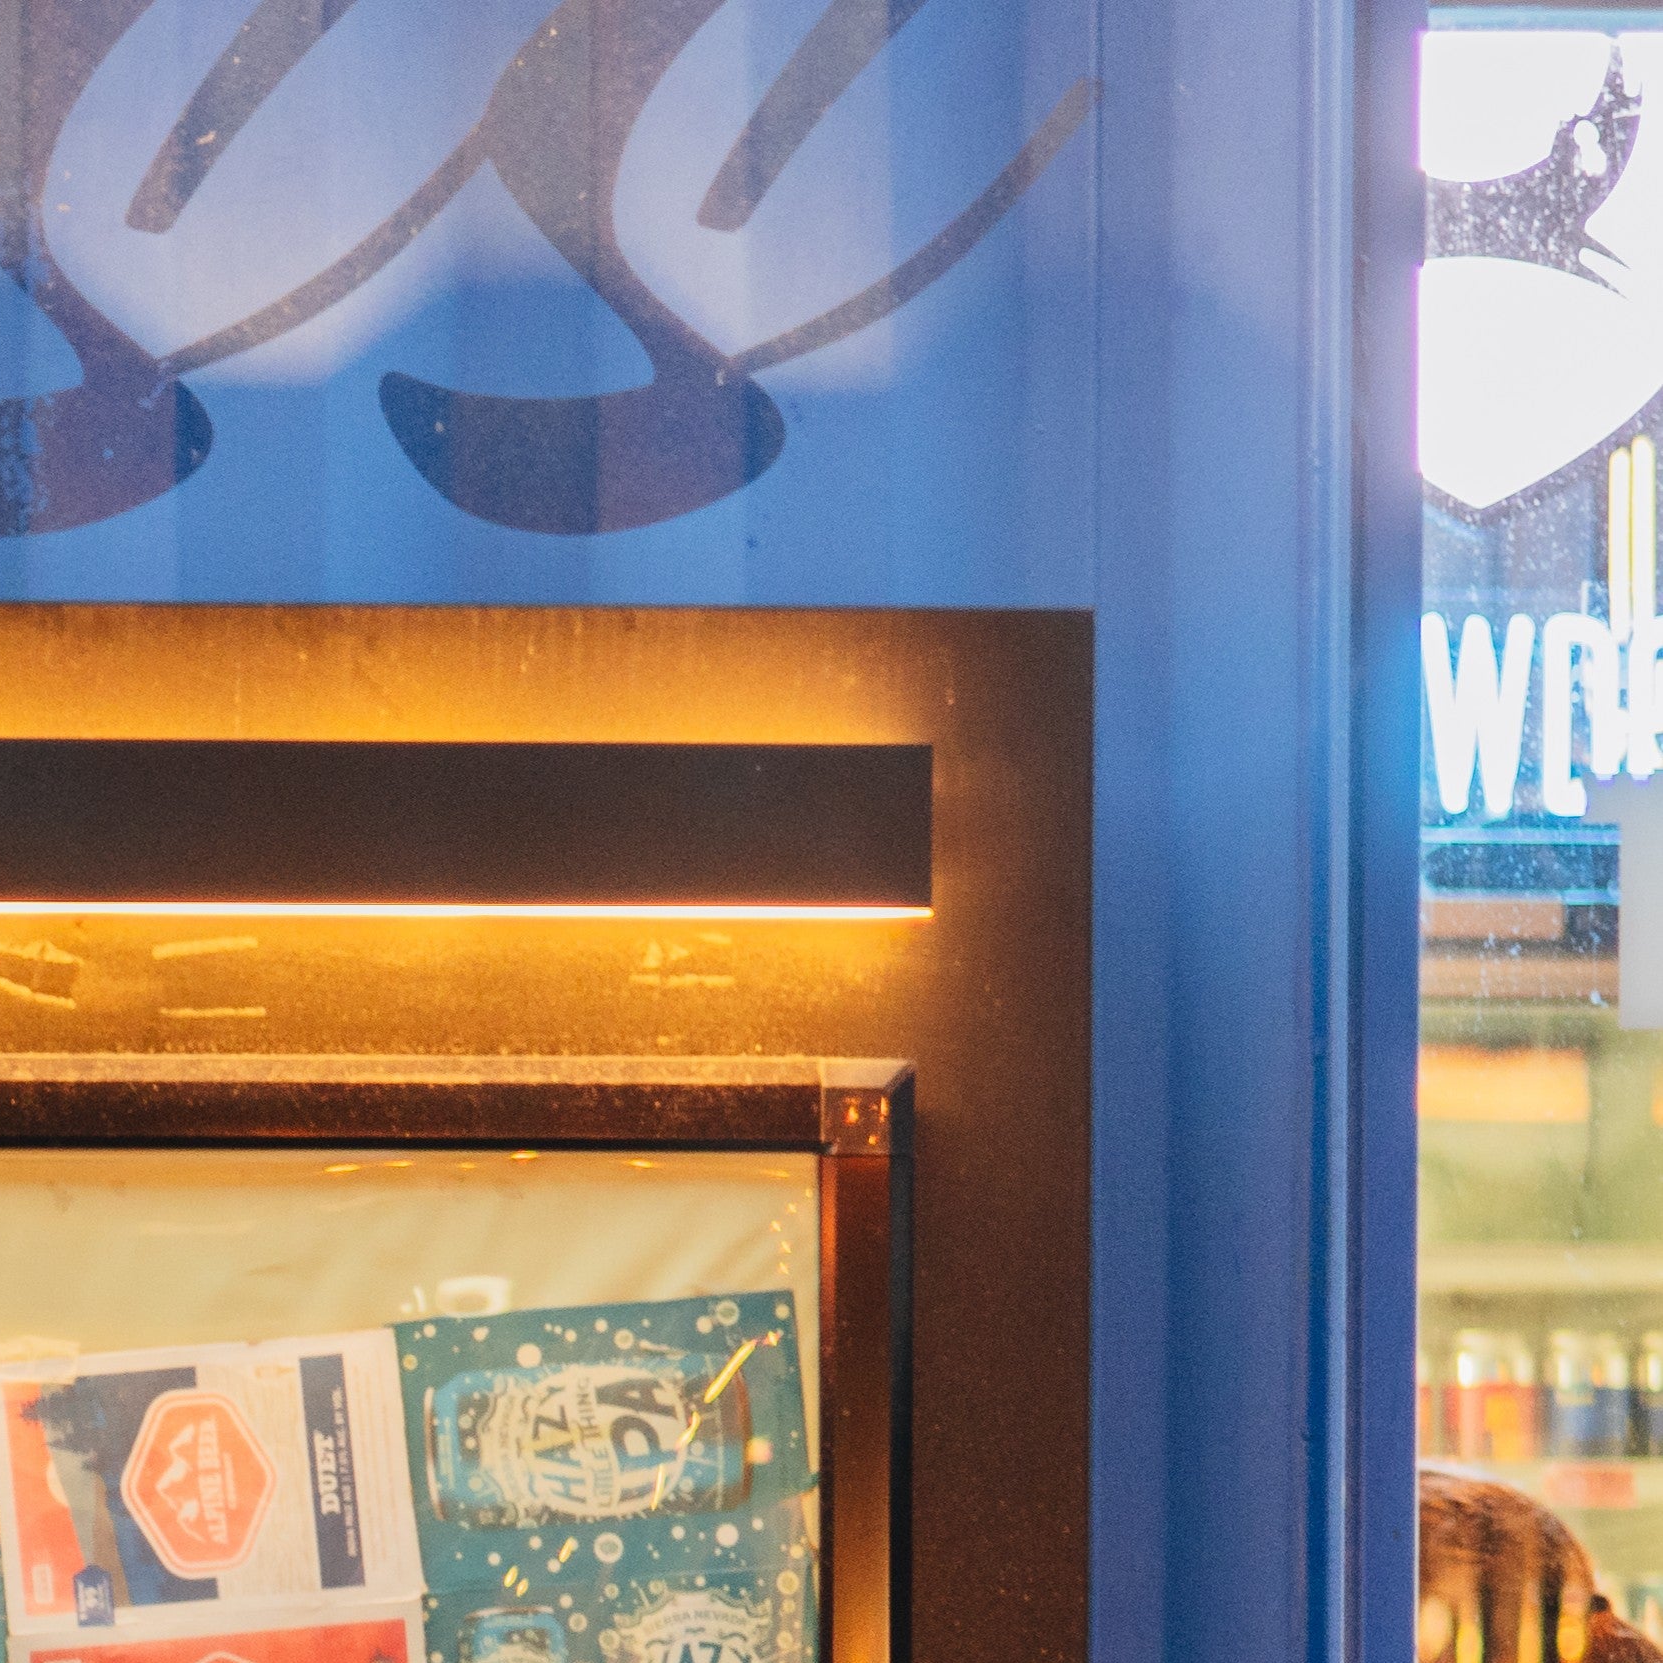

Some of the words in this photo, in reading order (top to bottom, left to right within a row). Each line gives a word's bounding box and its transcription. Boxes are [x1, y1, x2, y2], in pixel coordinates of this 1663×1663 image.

[532, 1384, 587, 1504] HAZY
[576, 1376, 602, 1443] THING
[595, 1377, 679, 1502] IPA
[197, 1473, 228, 1544] ALPINE
[313, 1430, 341, 1514] DUET
